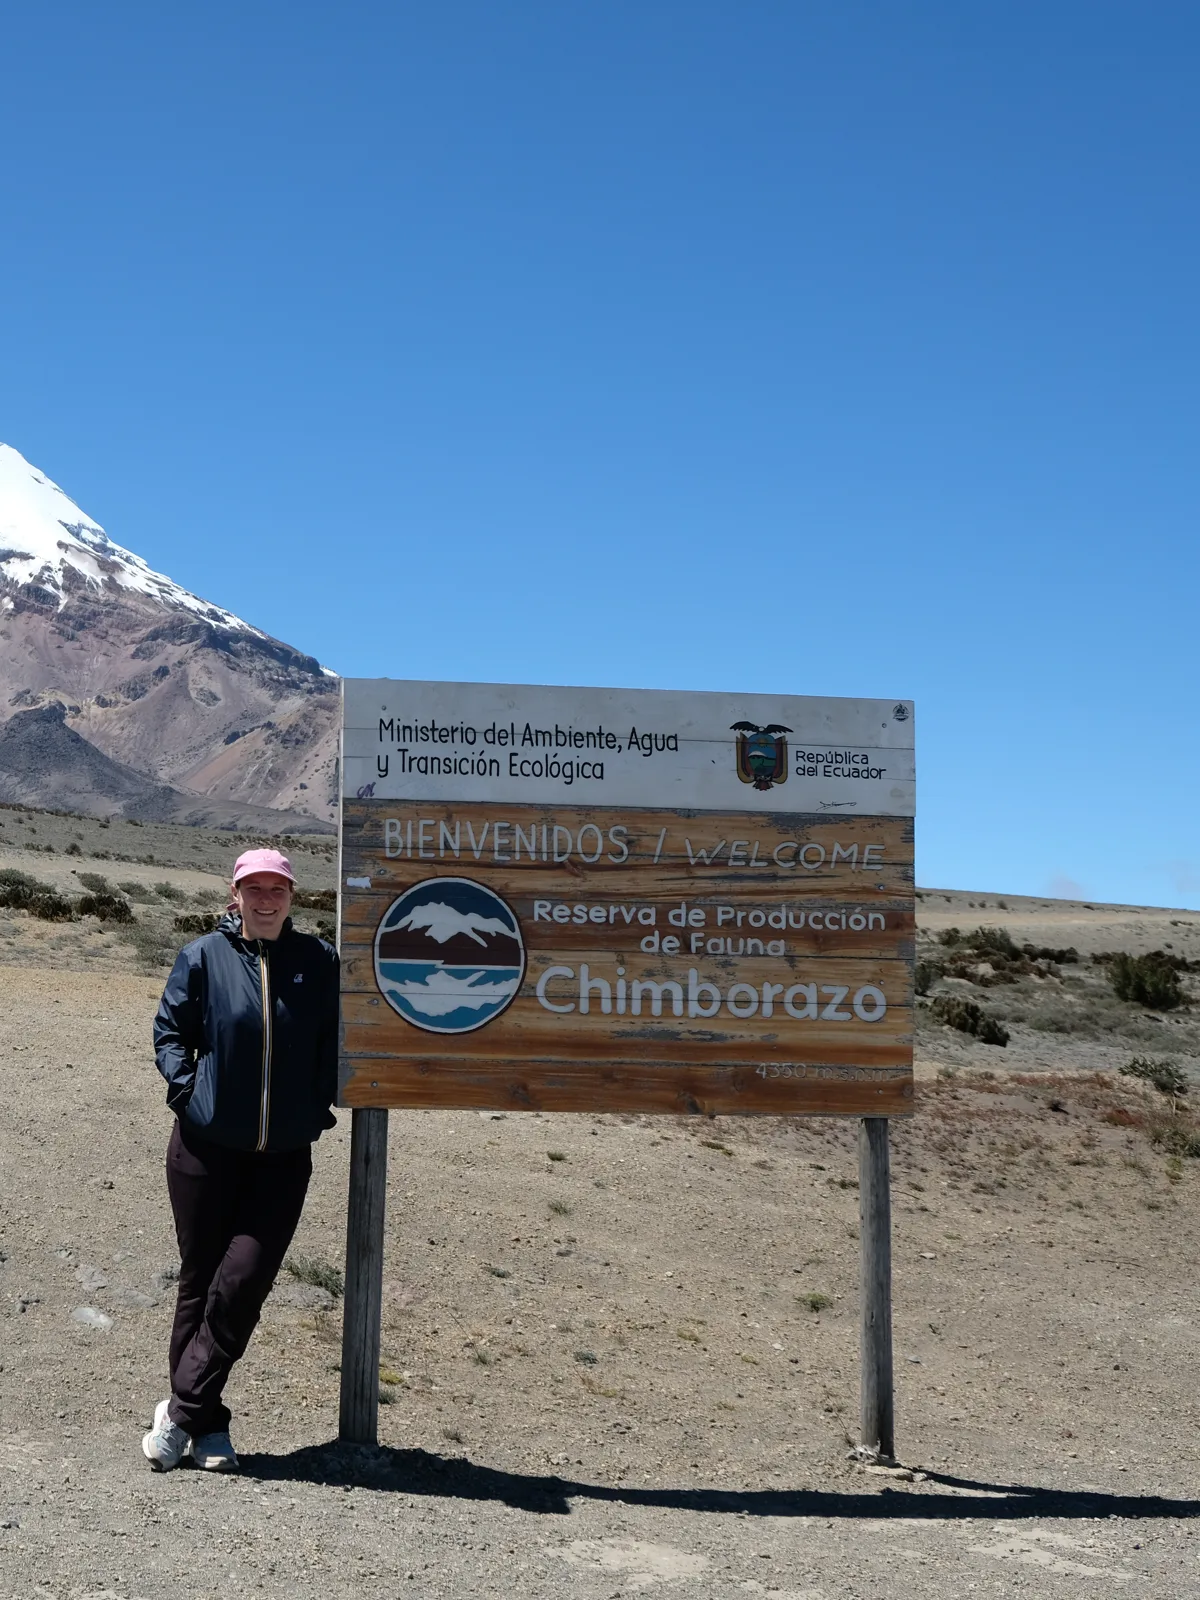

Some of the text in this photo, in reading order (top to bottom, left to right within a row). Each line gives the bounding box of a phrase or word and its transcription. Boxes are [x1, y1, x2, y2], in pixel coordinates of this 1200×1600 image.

[379, 717, 679, 757] Ministerio del Ambiente, Agua
[377, 749, 605, 785] y Transición Ecológica
[795, 750, 869, 765] República
[795, 764, 887, 780] del Ecuador
[384, 818, 886, 870] BIENVENIDOS / WELCOME
[533, 899, 886, 931] Reserva de Producción
[640, 931, 786, 957] de Fauna
[535, 963, 888, 1023] Chimborazo
[755, 1062, 807, 1079] 4350
